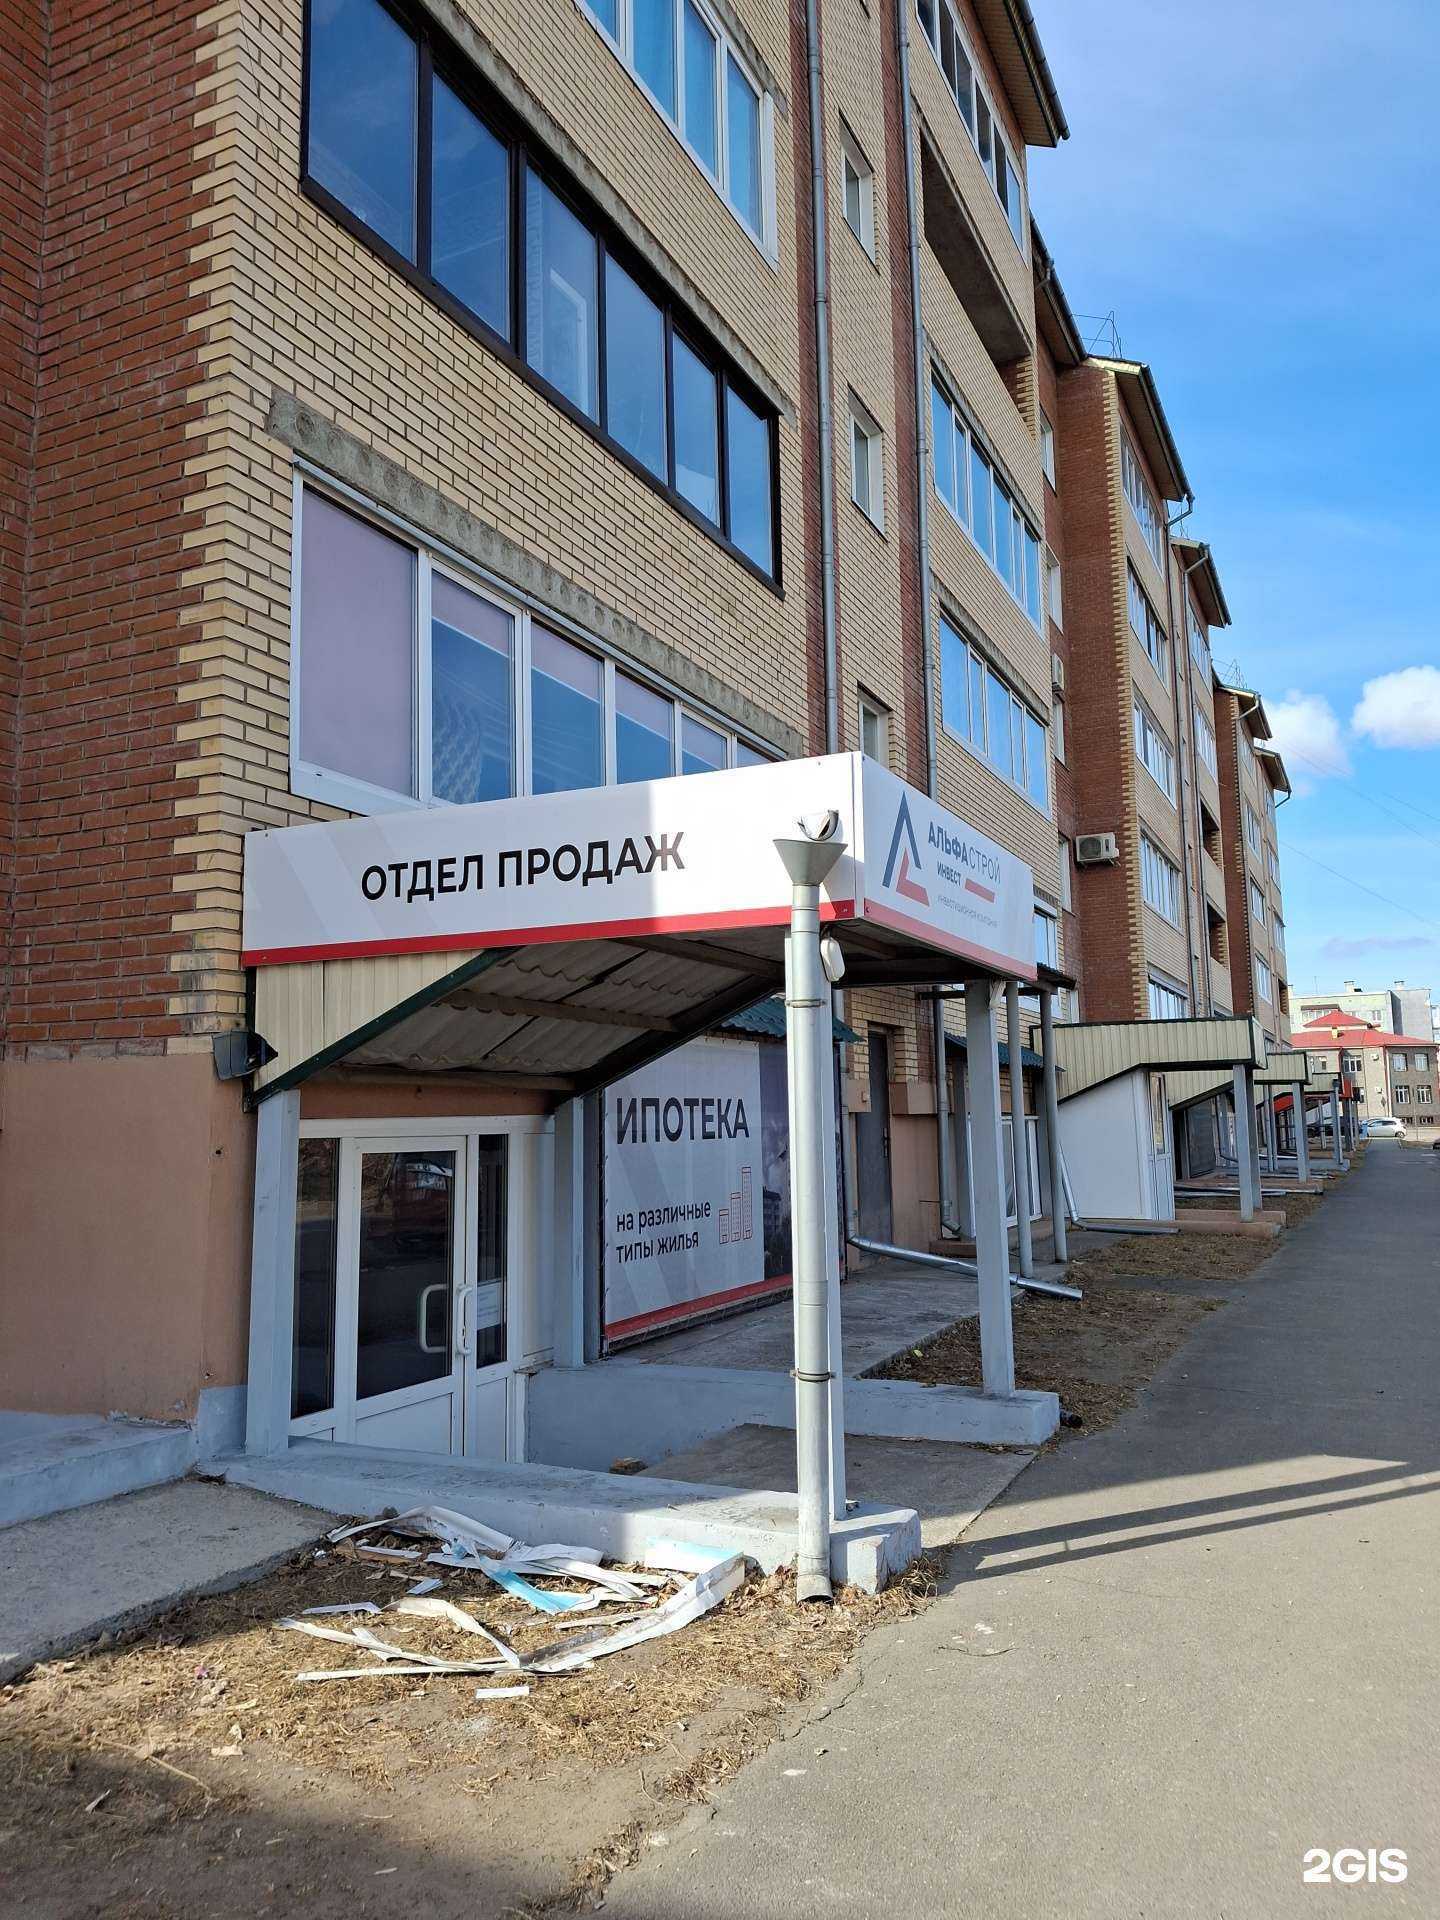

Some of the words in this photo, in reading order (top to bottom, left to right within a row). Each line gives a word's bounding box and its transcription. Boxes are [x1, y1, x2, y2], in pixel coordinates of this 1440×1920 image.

[361, 854, 484, 903] ОТДЕЛ
[498, 831, 685, 888] ПРОДАЖ
[937, 861, 961, 886] ИНВЕСТ
[616, 1097, 750, 1144] ИПОТЕКА
[616, 1212, 634, 1233] на
[638, 1201, 711, 1235] различные
[616, 1240, 654, 1264] типы
[657, 1231, 699, 1255] жилья
